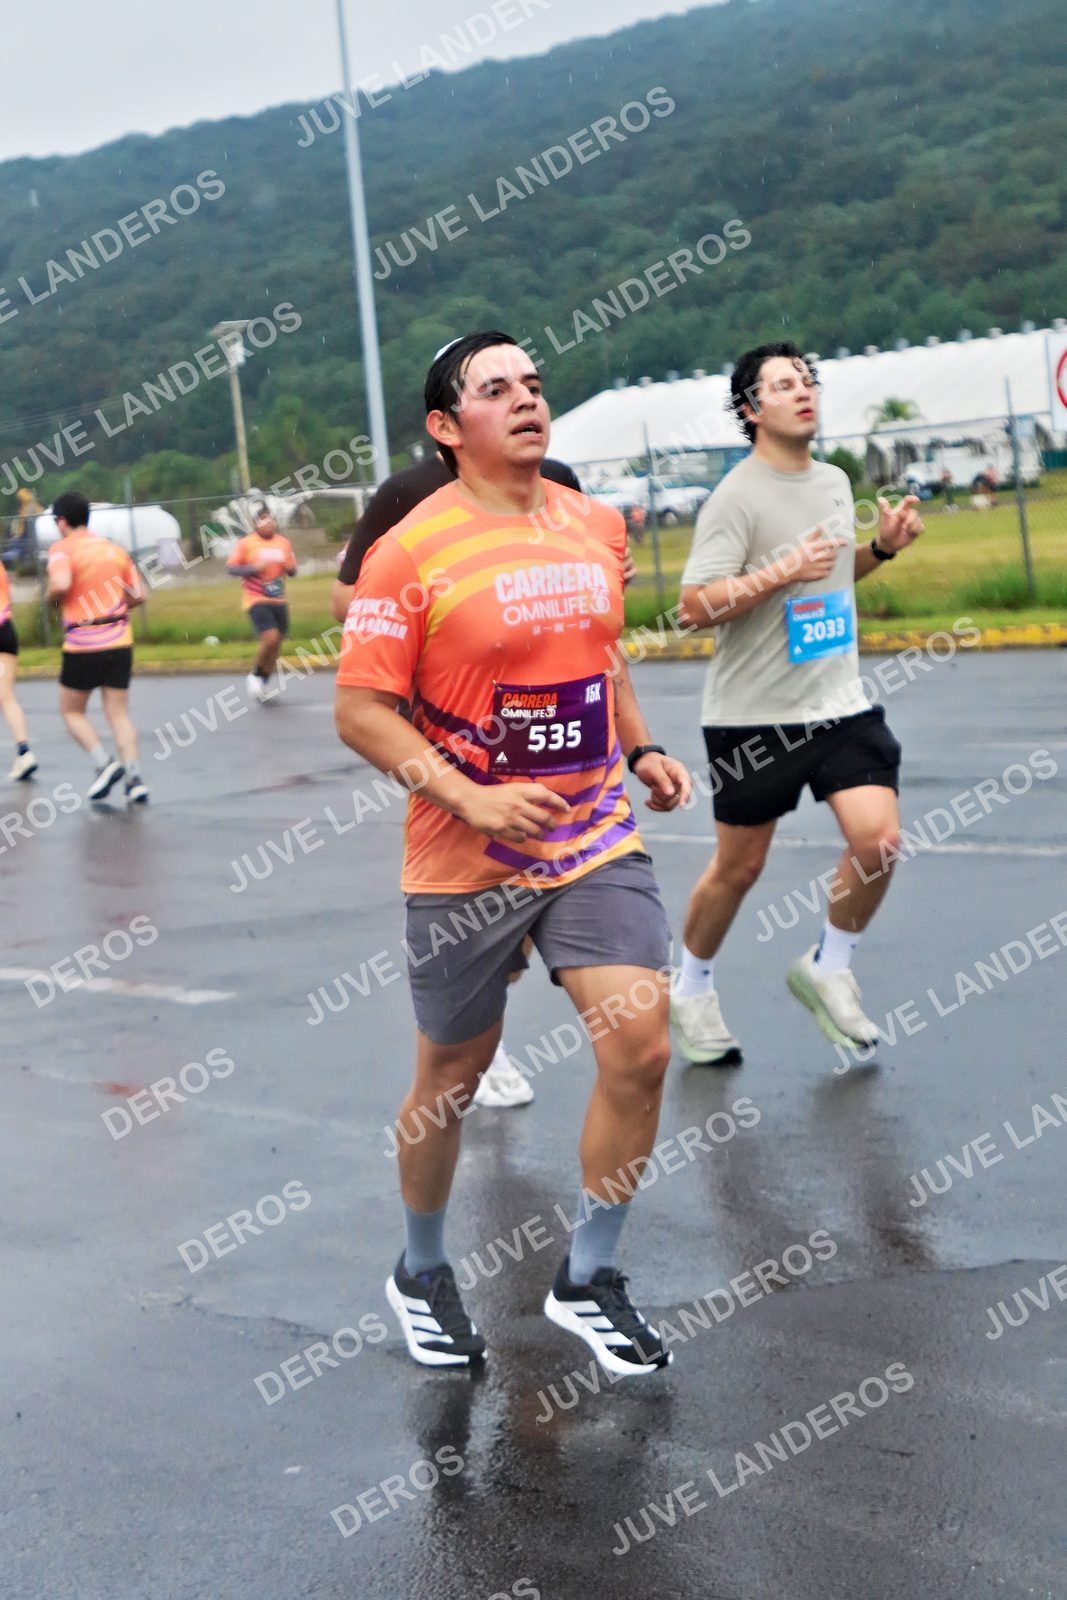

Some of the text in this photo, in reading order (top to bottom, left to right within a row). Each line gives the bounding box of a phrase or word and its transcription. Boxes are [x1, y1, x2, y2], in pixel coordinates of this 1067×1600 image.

[495, 562, 608, 603] CARRERA
[502, 594, 589, 625] OMNILIFE
[802, 616, 845, 643] 2033
[501, 692, 557, 708] CARRERA
[585, 682, 601, 704] 15K
[500, 707, 546, 720] OMNILIFE
[527, 720, 582, 753] 535
